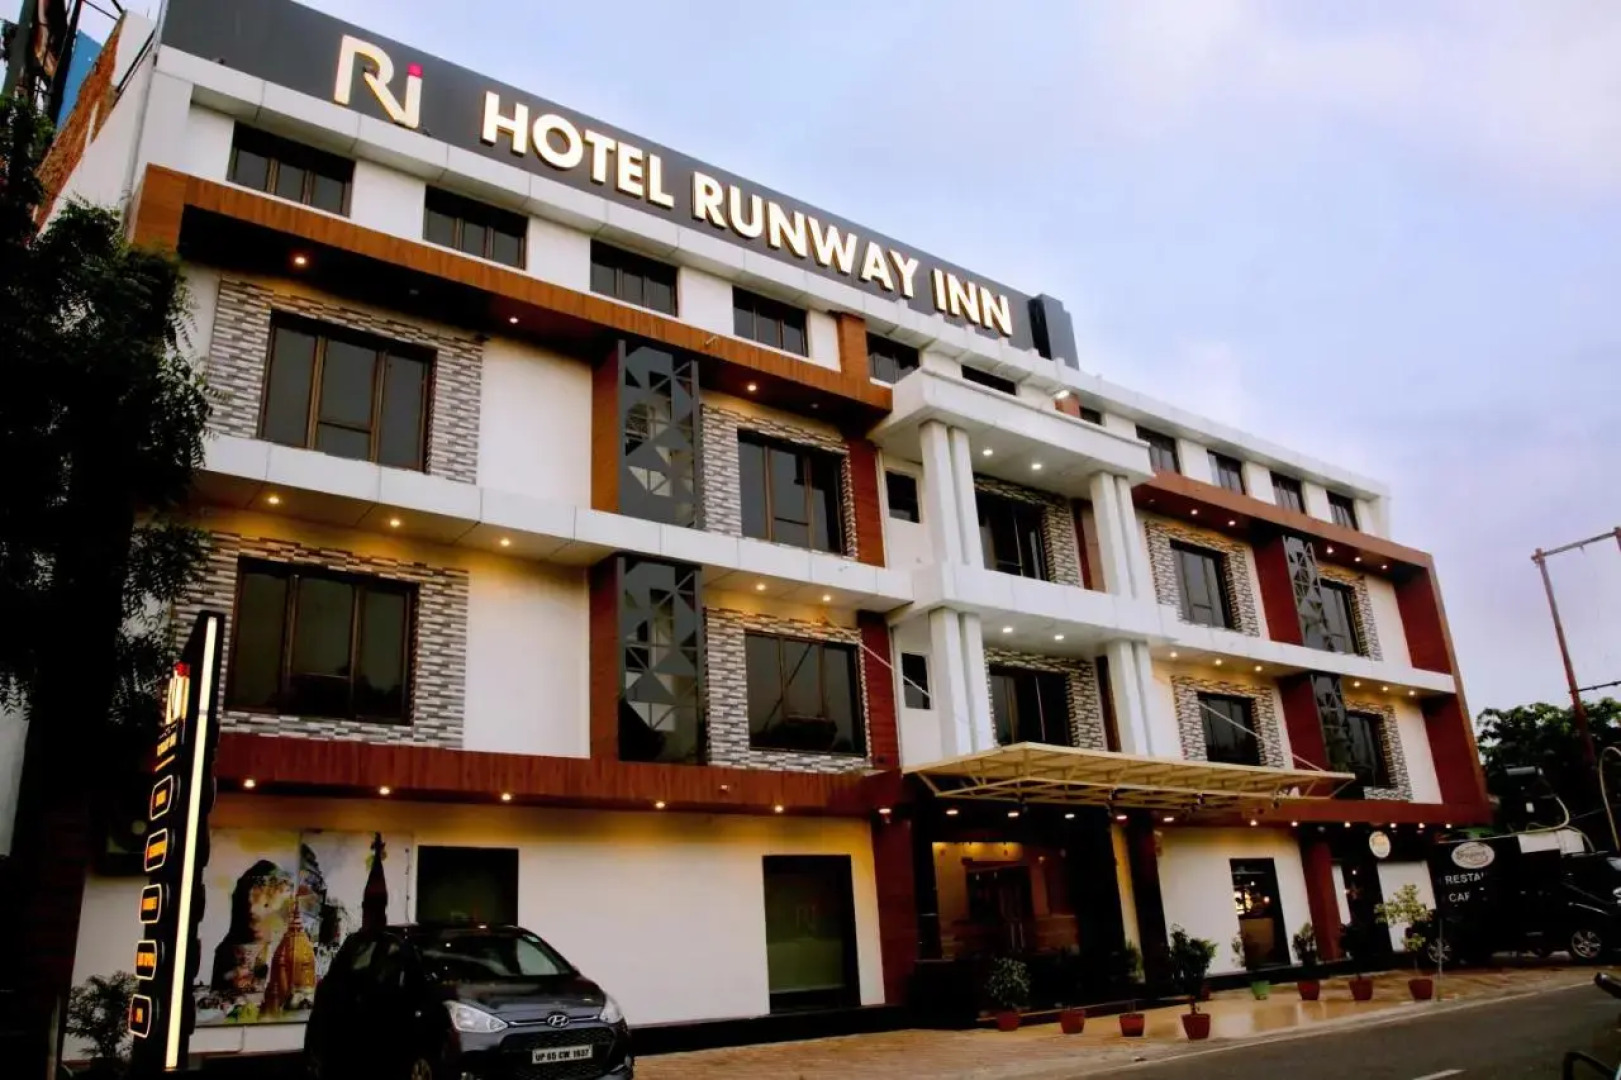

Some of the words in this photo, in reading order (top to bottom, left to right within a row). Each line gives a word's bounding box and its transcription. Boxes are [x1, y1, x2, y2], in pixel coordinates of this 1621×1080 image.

[480, 91, 674, 209] HOTEL
[691, 170, 919, 298] RUNWAY
[933, 267, 1013, 336] INN
[535, 1053, 546, 1061] UP
